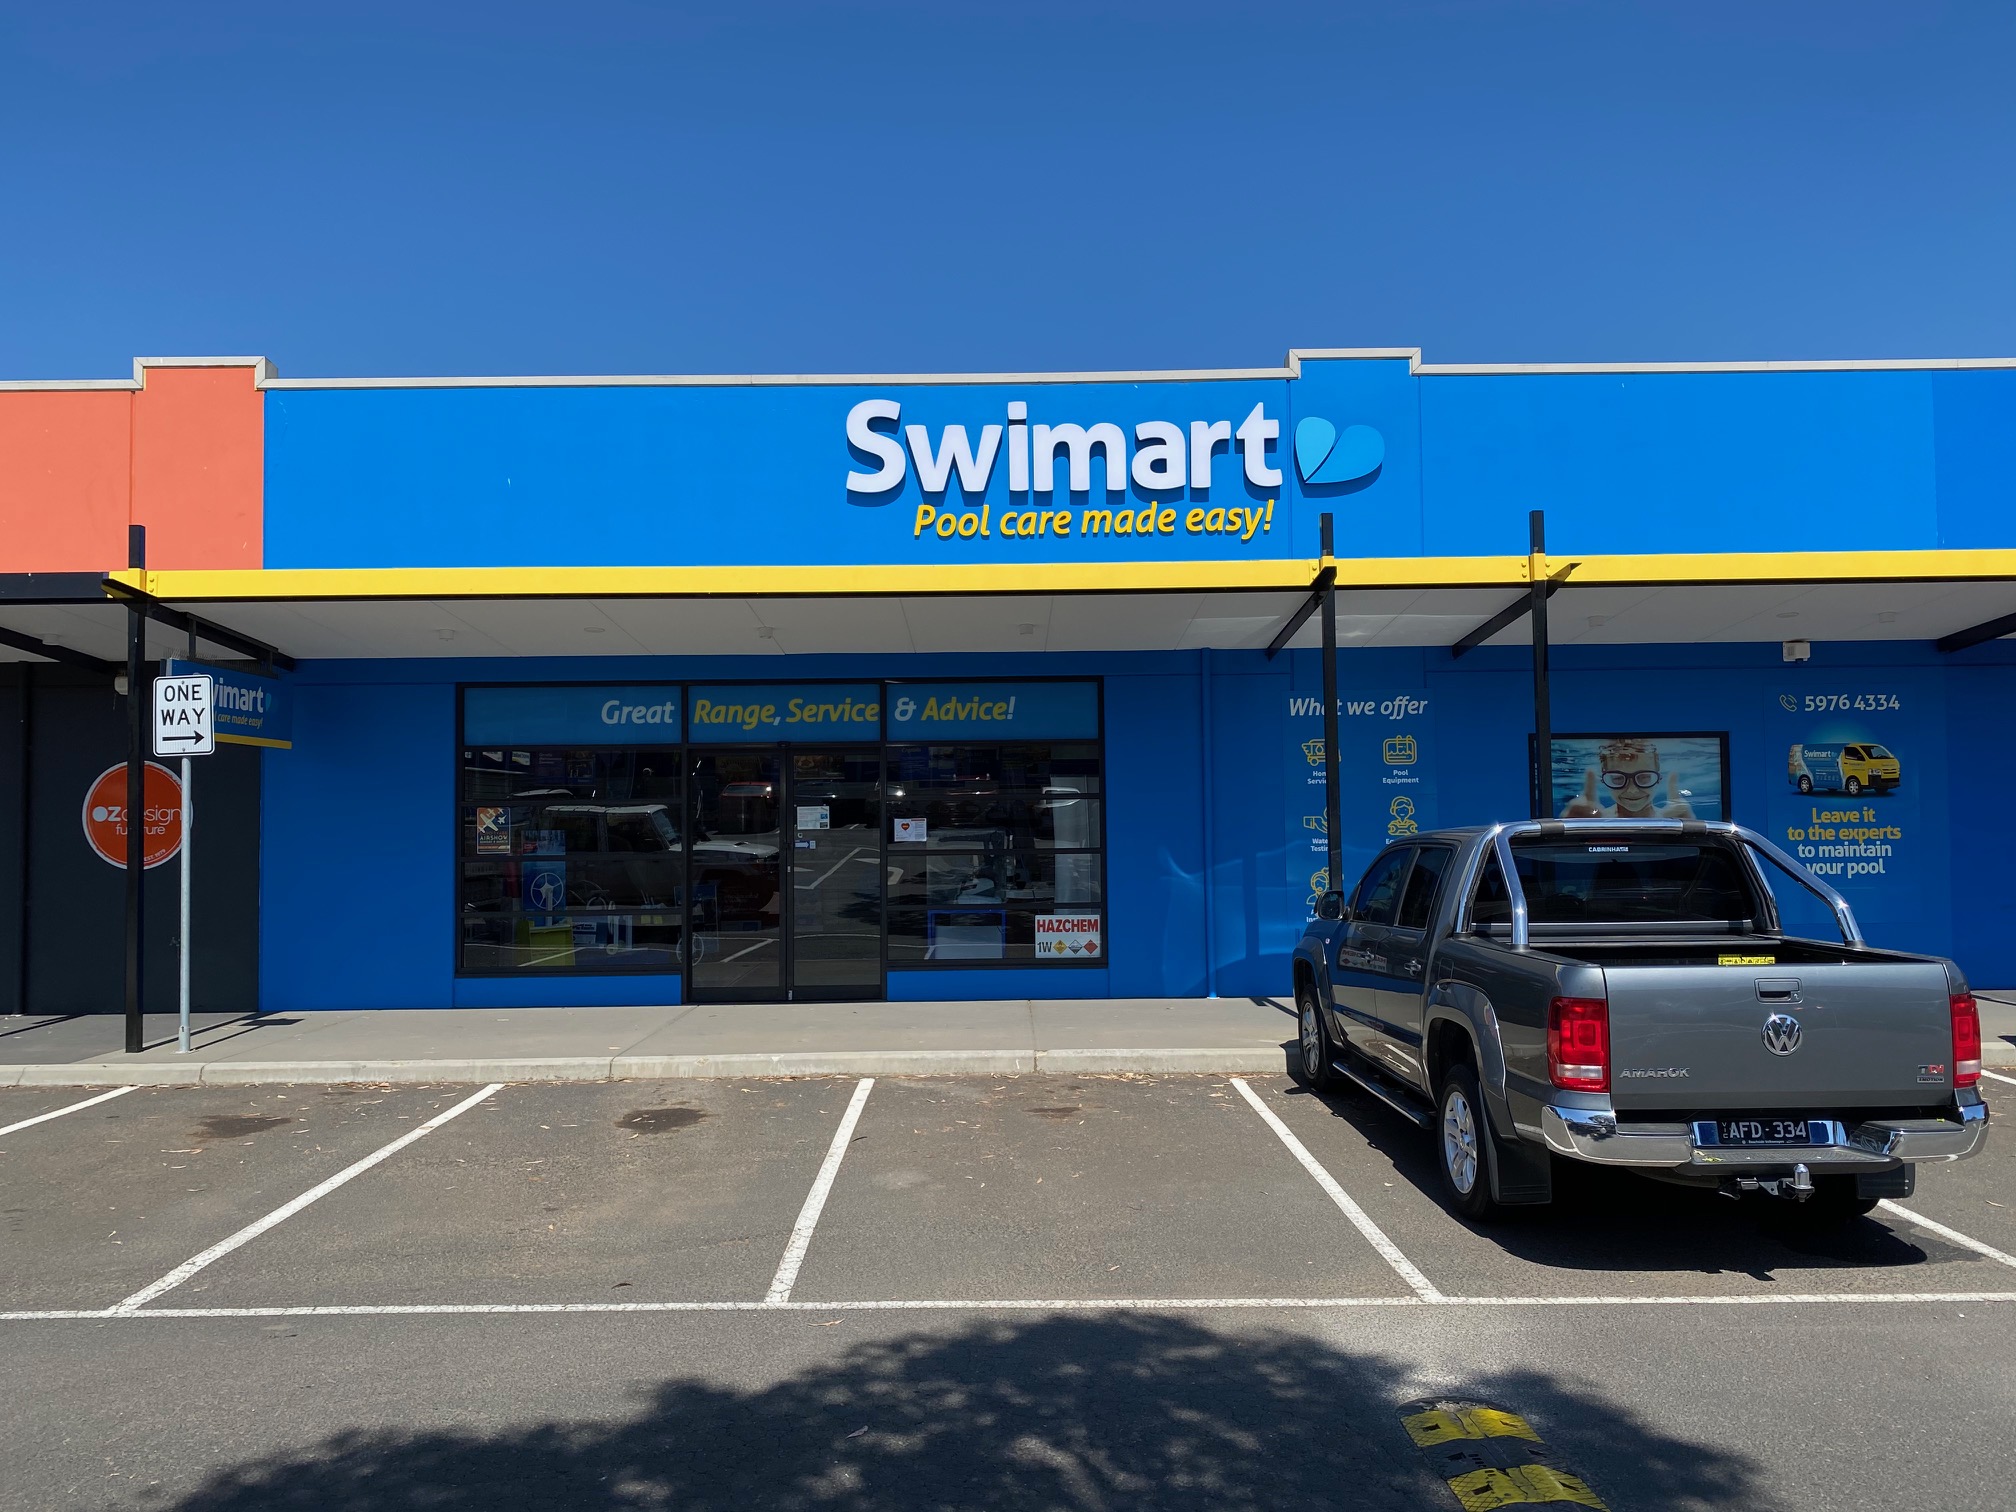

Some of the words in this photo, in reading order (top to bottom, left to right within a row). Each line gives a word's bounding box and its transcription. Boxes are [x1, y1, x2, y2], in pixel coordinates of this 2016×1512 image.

[845, 398, 1283, 494] Swimart
[914, 504, 991, 537] Pool
[999, 510, 1071, 538] care
[1081, 501, 1176, 536] made
[1185, 499, 1275, 541] easy!
[164, 684, 203, 702] ONE
[1347, 700, 1376, 716] we
[1380, 695, 1429, 720] offer
[1804, 694, 1851, 711] 5976
[1853, 694, 1900, 711] 4334
[161, 707, 206, 726] WAY
[218, 713, 231, 723] care
[232, 714, 248, 726] made
[601, 699, 675, 725] Great
[693, 699, 781, 730] Range,
[785, 697, 881, 723] Service
[894, 697, 917, 722] &
[920, 696, 1016, 721] Advice!
[1804, 749, 1832, 758] Swimart
[1382, 777, 1420, 785] Equipment
[1812, 807, 1860, 824] Leave
[1862, 806, 1876, 823] it
[1787, 826, 1805, 841] to
[1808, 825, 1836, 840] the
[1838, 825, 1902, 844] experts
[1797, 843, 1815, 858] to
[1818, 841, 1892, 857] maintain
[1805, 862, 1845, 875] your
[1847, 858, 1886, 879] pool
[1036, 919, 1099, 933] HAZCHEM
[1037, 941, 1053, 953] 1W
[1619, 1067, 1691, 1079] AMAROK
